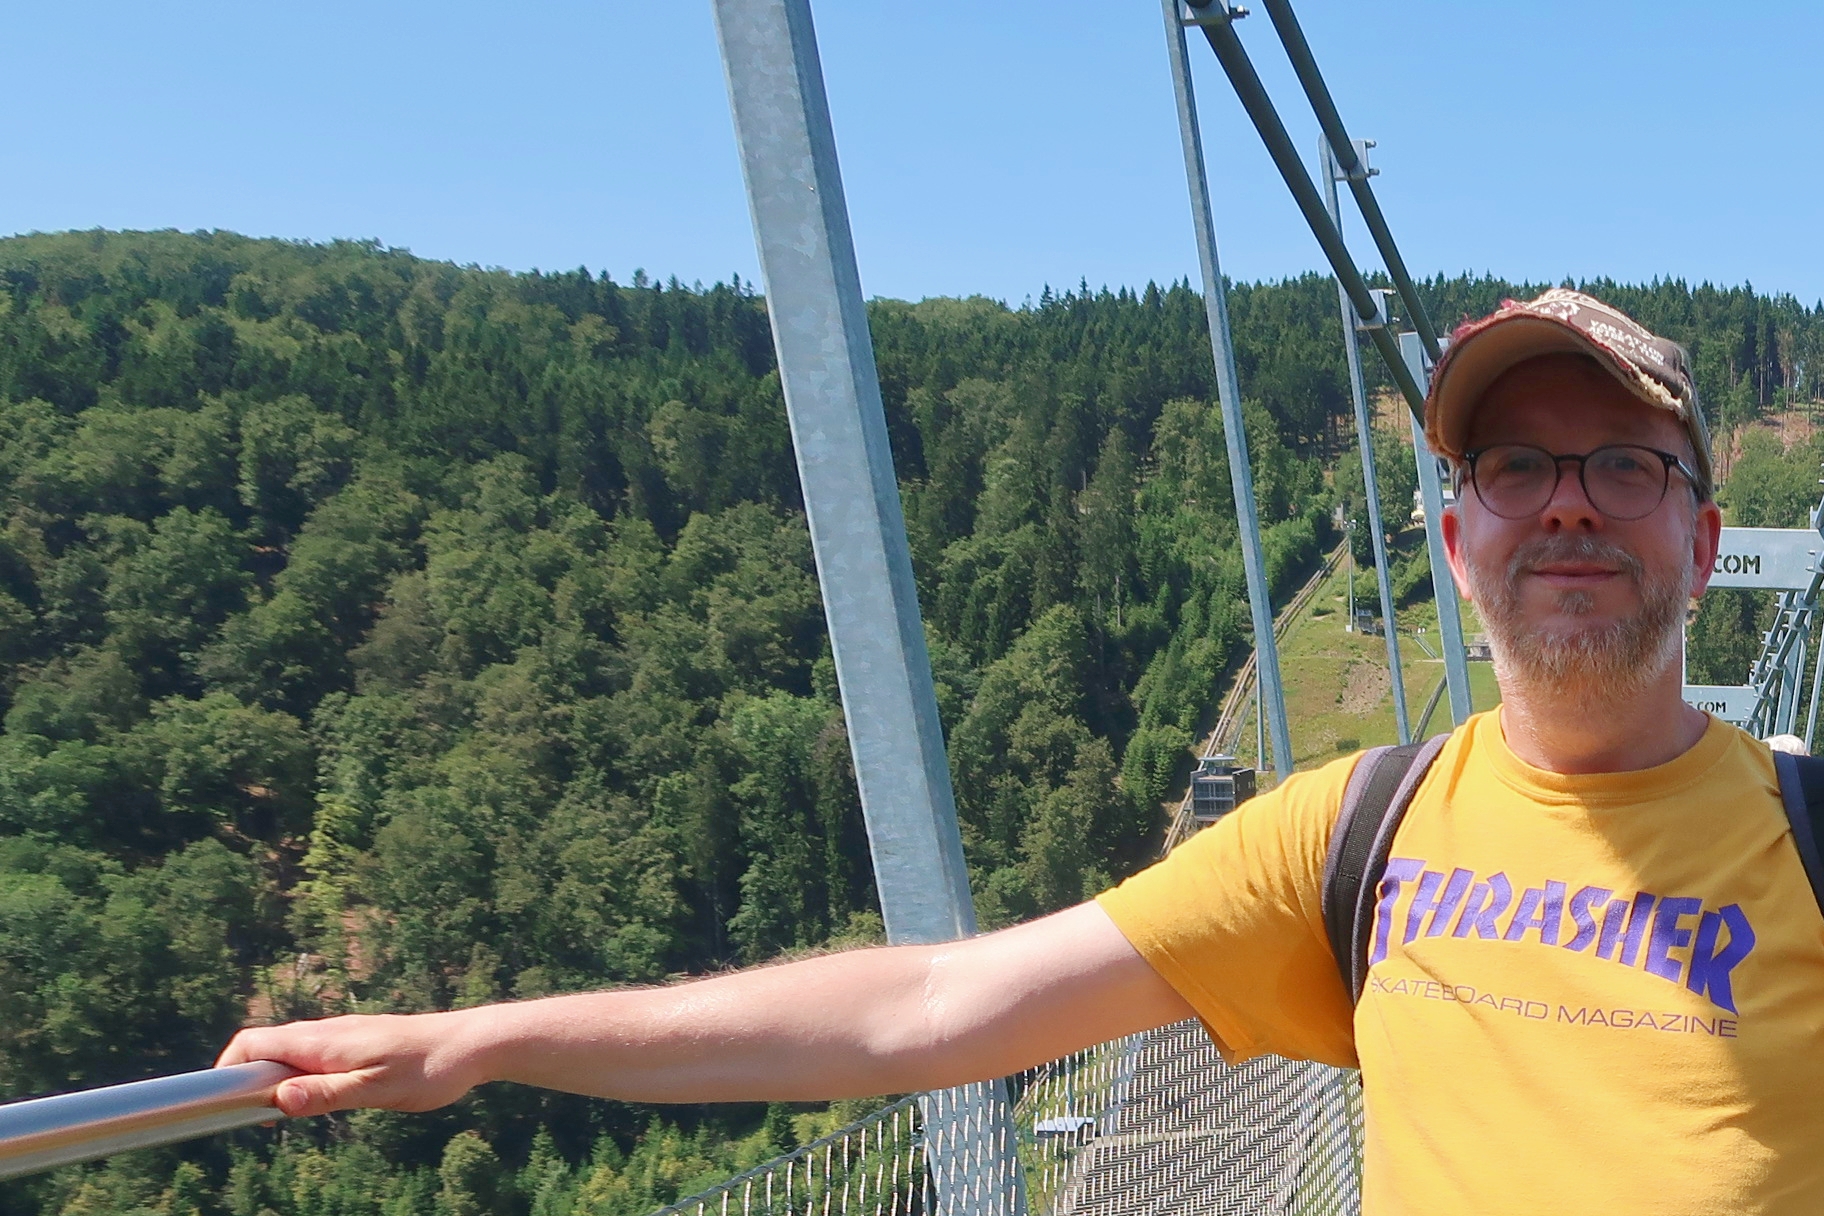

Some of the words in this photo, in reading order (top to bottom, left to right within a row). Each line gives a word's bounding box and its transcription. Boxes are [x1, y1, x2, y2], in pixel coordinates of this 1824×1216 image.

[1689, 701, 1727, 713] COM
[1369, 857, 1756, 1016] THRASHER
[1371, 976, 1549, 1020] SKATEBOARD
[1557, 1005, 1738, 1038] MAGAZINE
